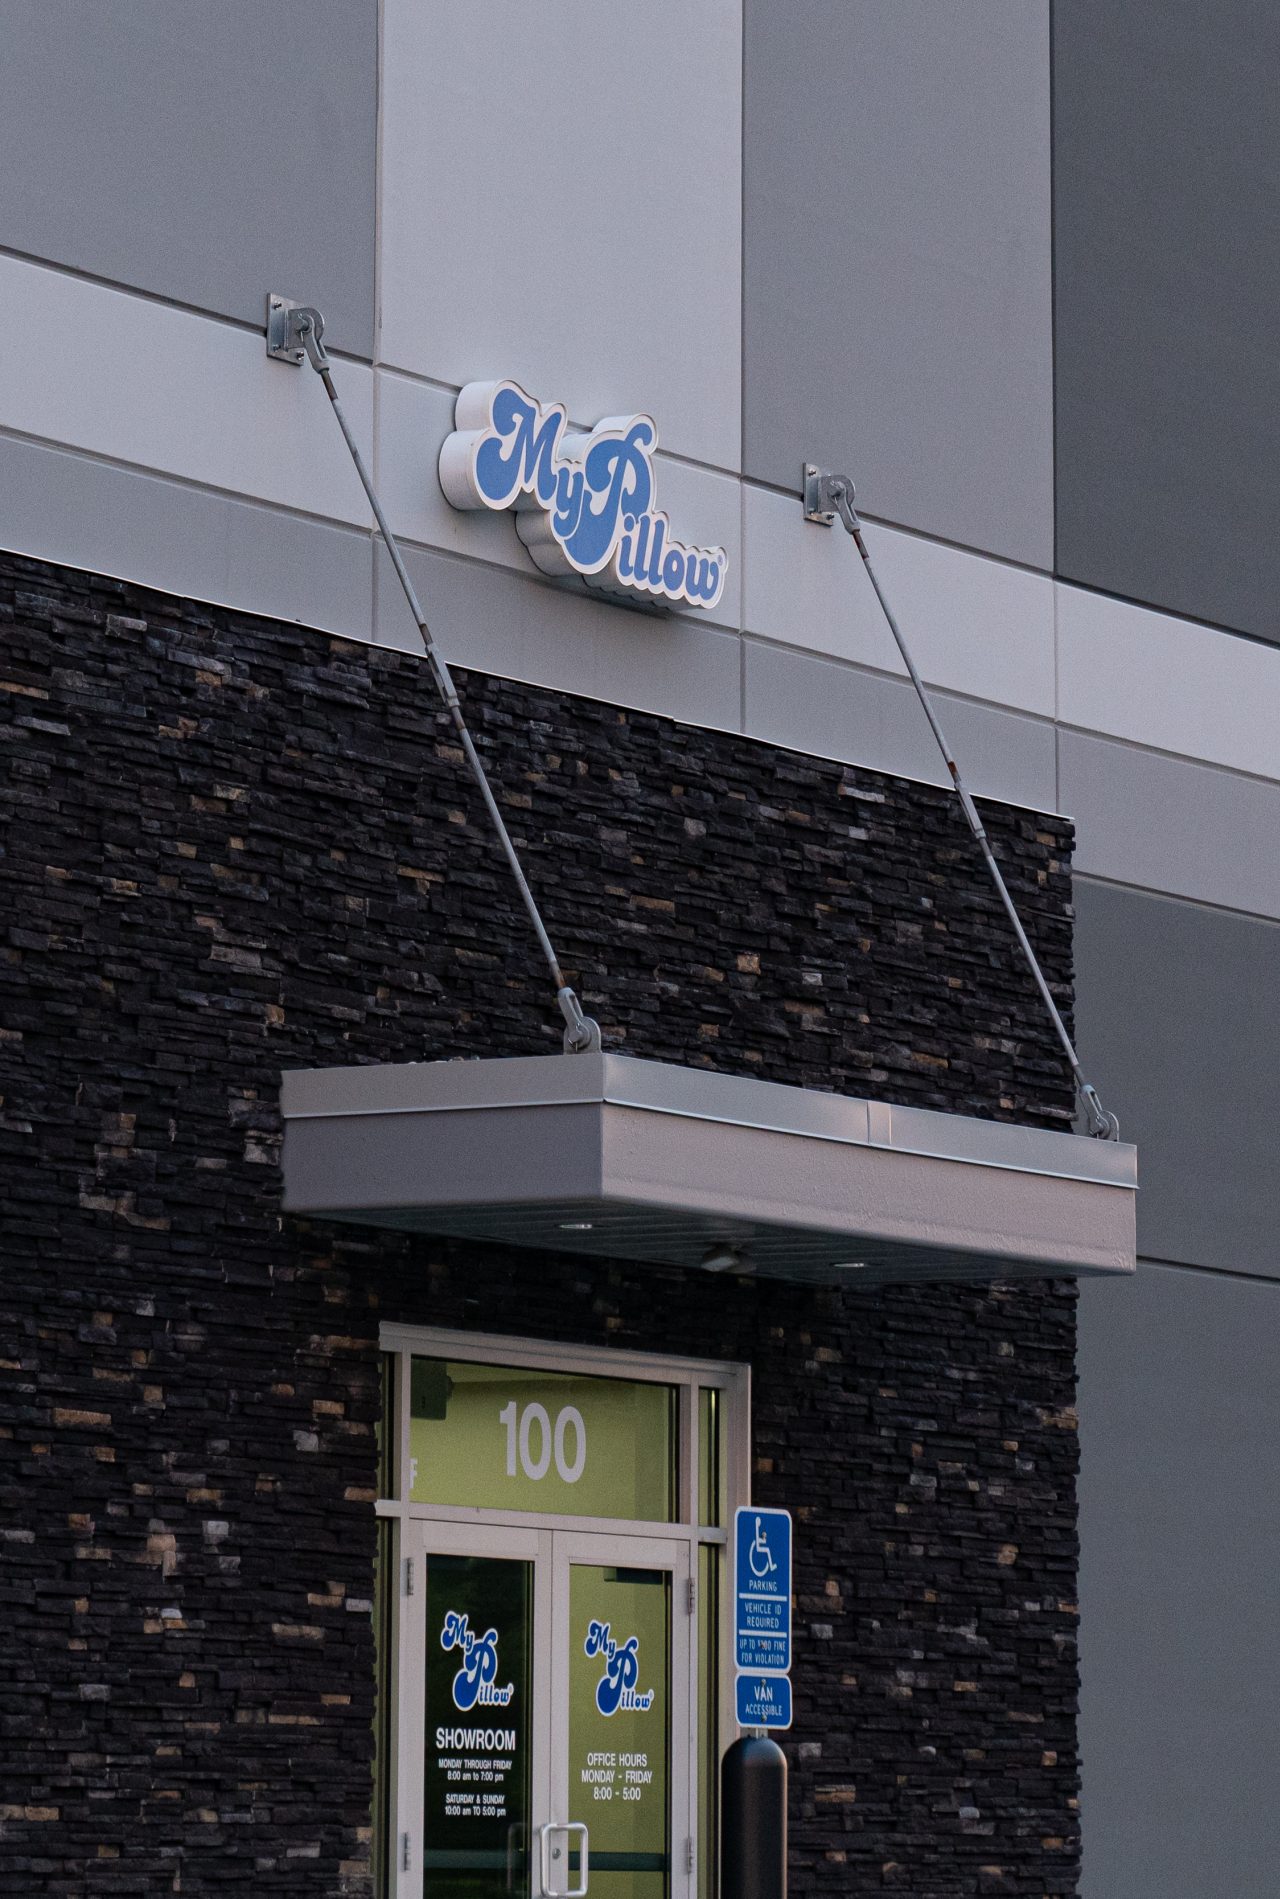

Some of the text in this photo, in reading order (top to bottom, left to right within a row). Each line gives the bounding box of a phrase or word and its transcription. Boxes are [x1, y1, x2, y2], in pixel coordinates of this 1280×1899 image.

[500, 1401, 586, 1484] 100
[749, 1580, 777, 1592] PARKING
[745, 1603, 781, 1615] VEHICLE ID
[747, 1616, 779, 1629] REQUIRED
[774, 1640, 786, 1652] FINE
[742, 1652, 784, 1665] FOR VIOLATION
[754, 1686, 773, 1701] VAN
[745, 1703, 782, 1716] ACCESSIBLE
[436, 1727, 516, 1751] SHOWROOM
[438, 1759, 512, 1770] MONDAY THROUGH FRIDAY
[587, 1753, 648, 1767] OFFICE HOURS
[447, 1771, 461, 1780] 8:00
[473, 1772, 479, 1780] to
[481, 1772, 493, 1781] 7:00
[494, 1774, 504, 1783] pm
[581, 1770, 615, 1783] MONDAY
[625, 1770, 653, 1783] FRIDAY
[445, 1794, 505, 1804] SATURDAY & SUNDAY
[593, 1786, 612, 1800] 8:00
[622, 1787, 641, 1800] 5:00
[445, 1806, 461, 1815] 10:00
[473, 1806, 481, 1816] TO
[482, 1807, 495, 1816] 5:00
[496, 1808, 506, 1817] pm
